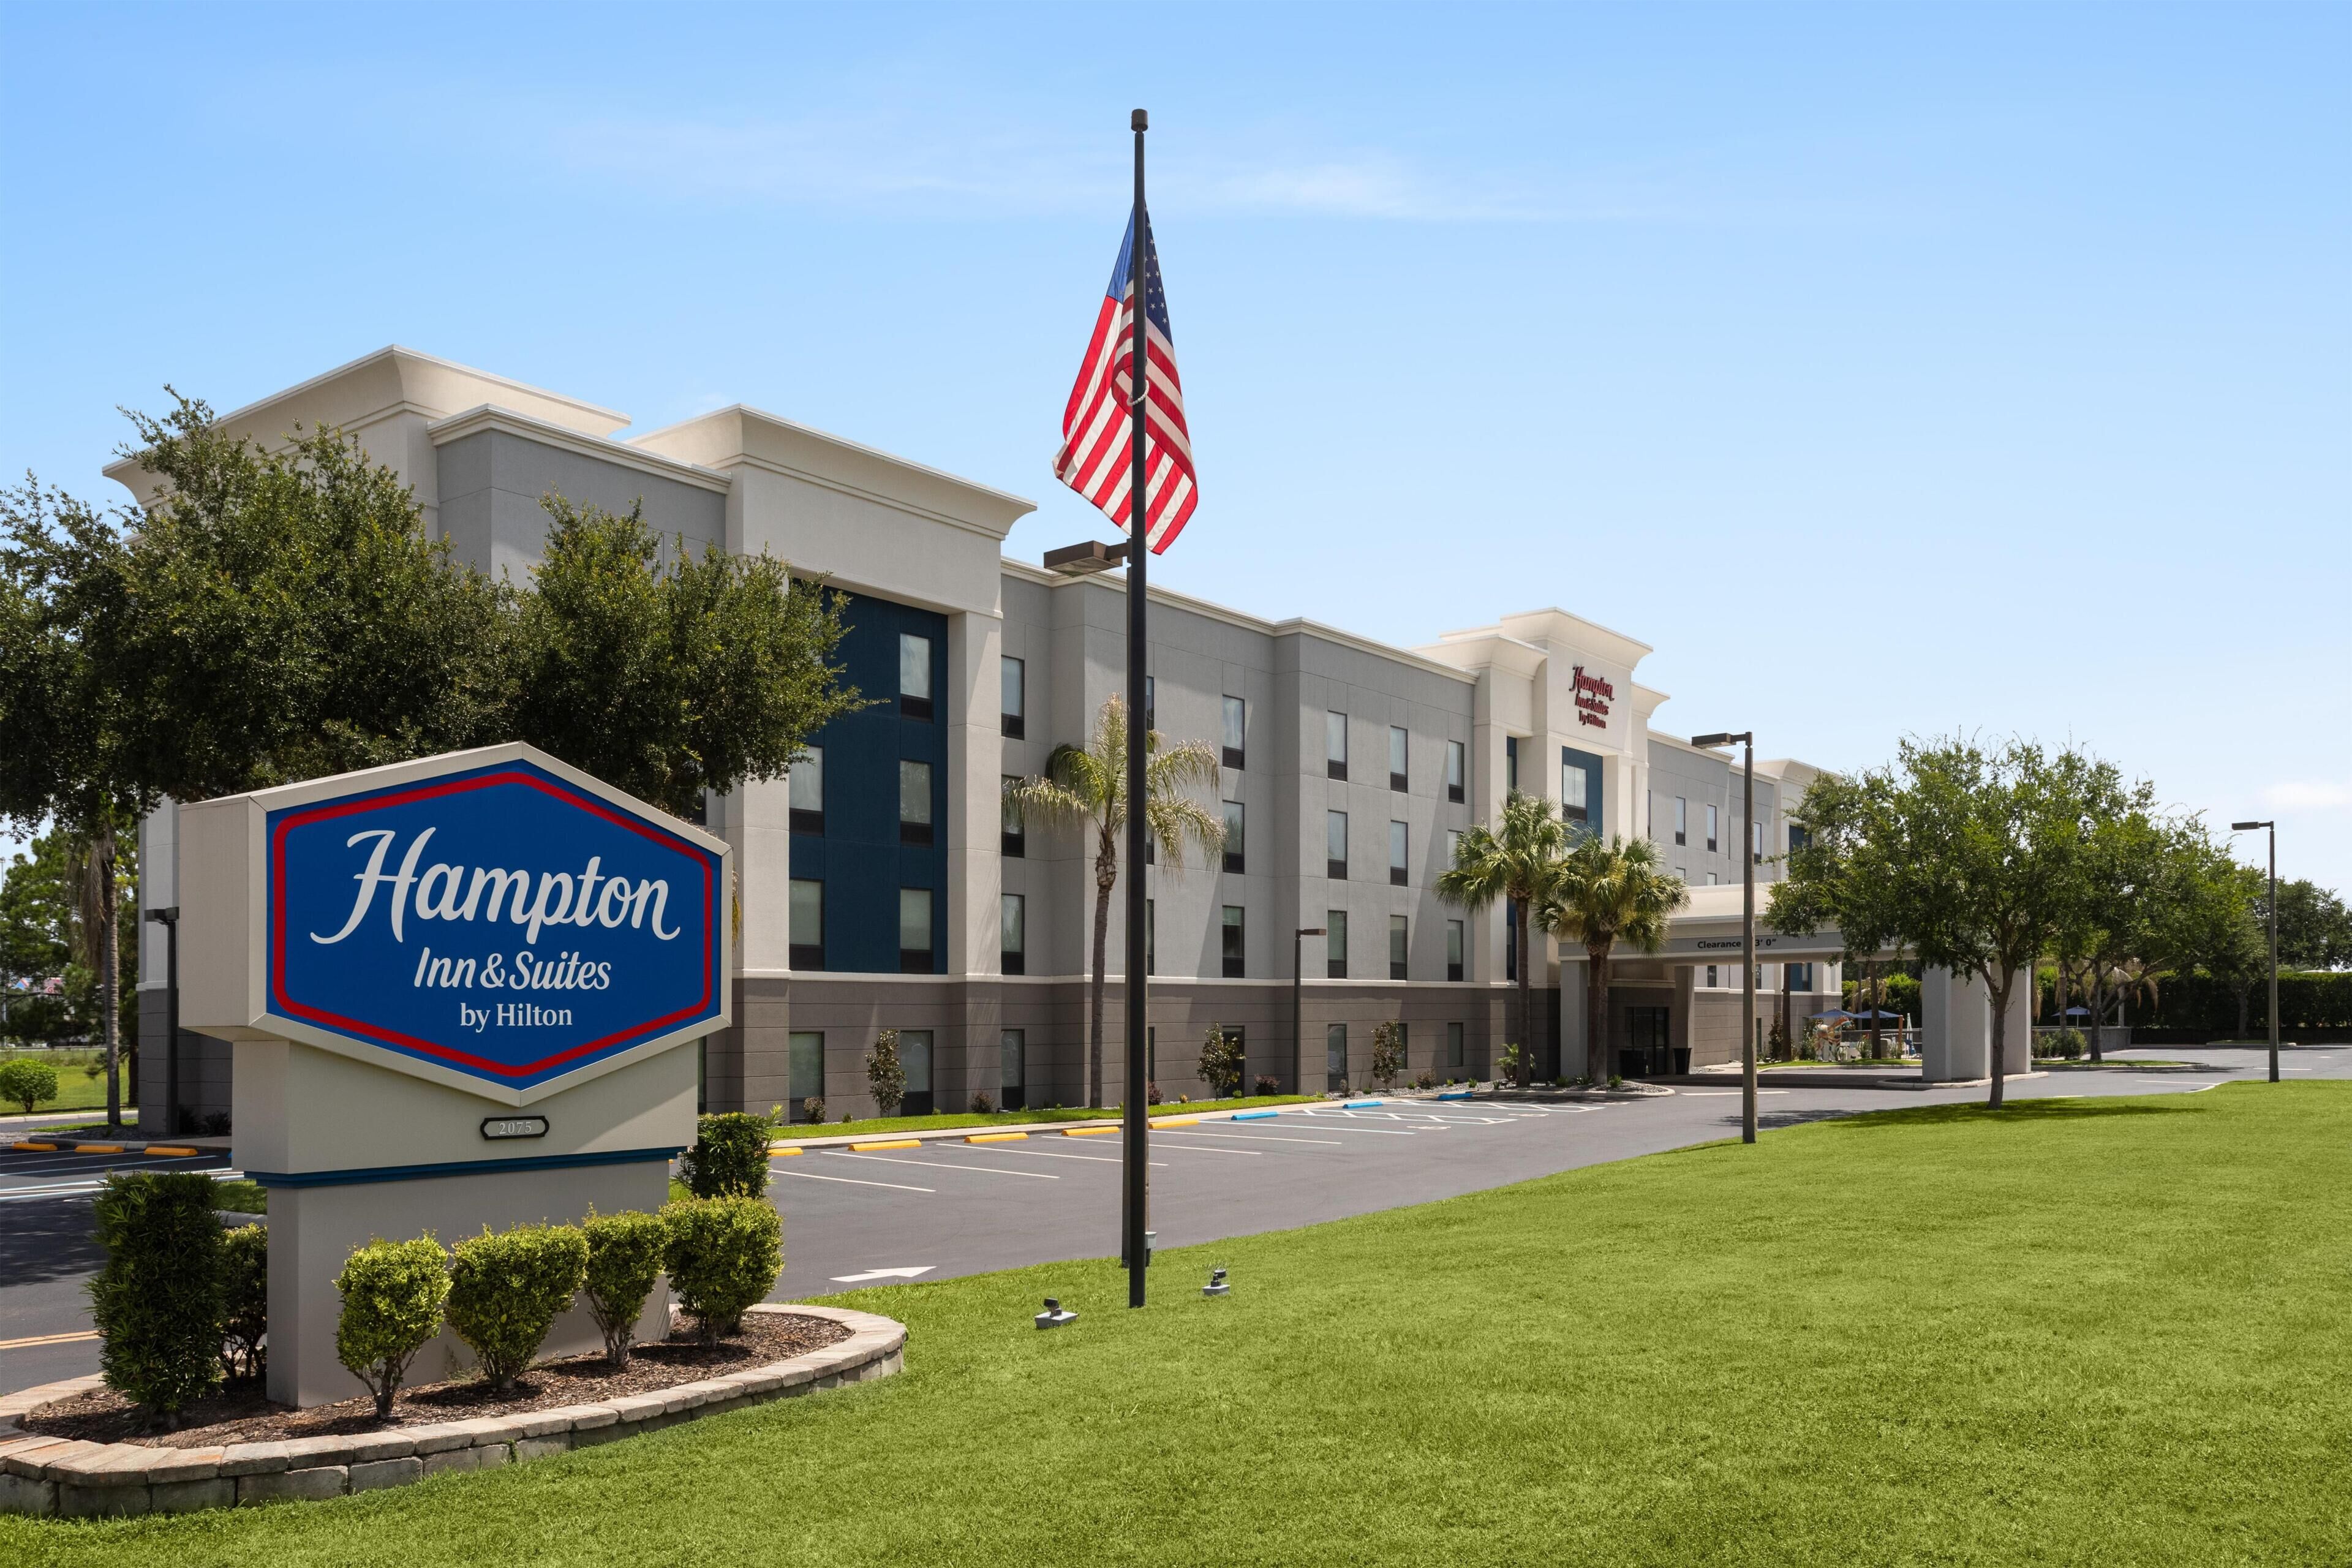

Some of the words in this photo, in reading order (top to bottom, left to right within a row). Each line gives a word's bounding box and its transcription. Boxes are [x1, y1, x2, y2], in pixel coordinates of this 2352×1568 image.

[1569, 666, 1615, 701] Hampton
[1579, 710, 1587, 725] by
[1587, 714, 1606, 729] Hilton
[310, 827, 680, 944] Hampton
[460, 1003, 491, 1033] by
[496, 1003, 573, 1027] Hilton
[499, 1121, 532, 1134] 2075
